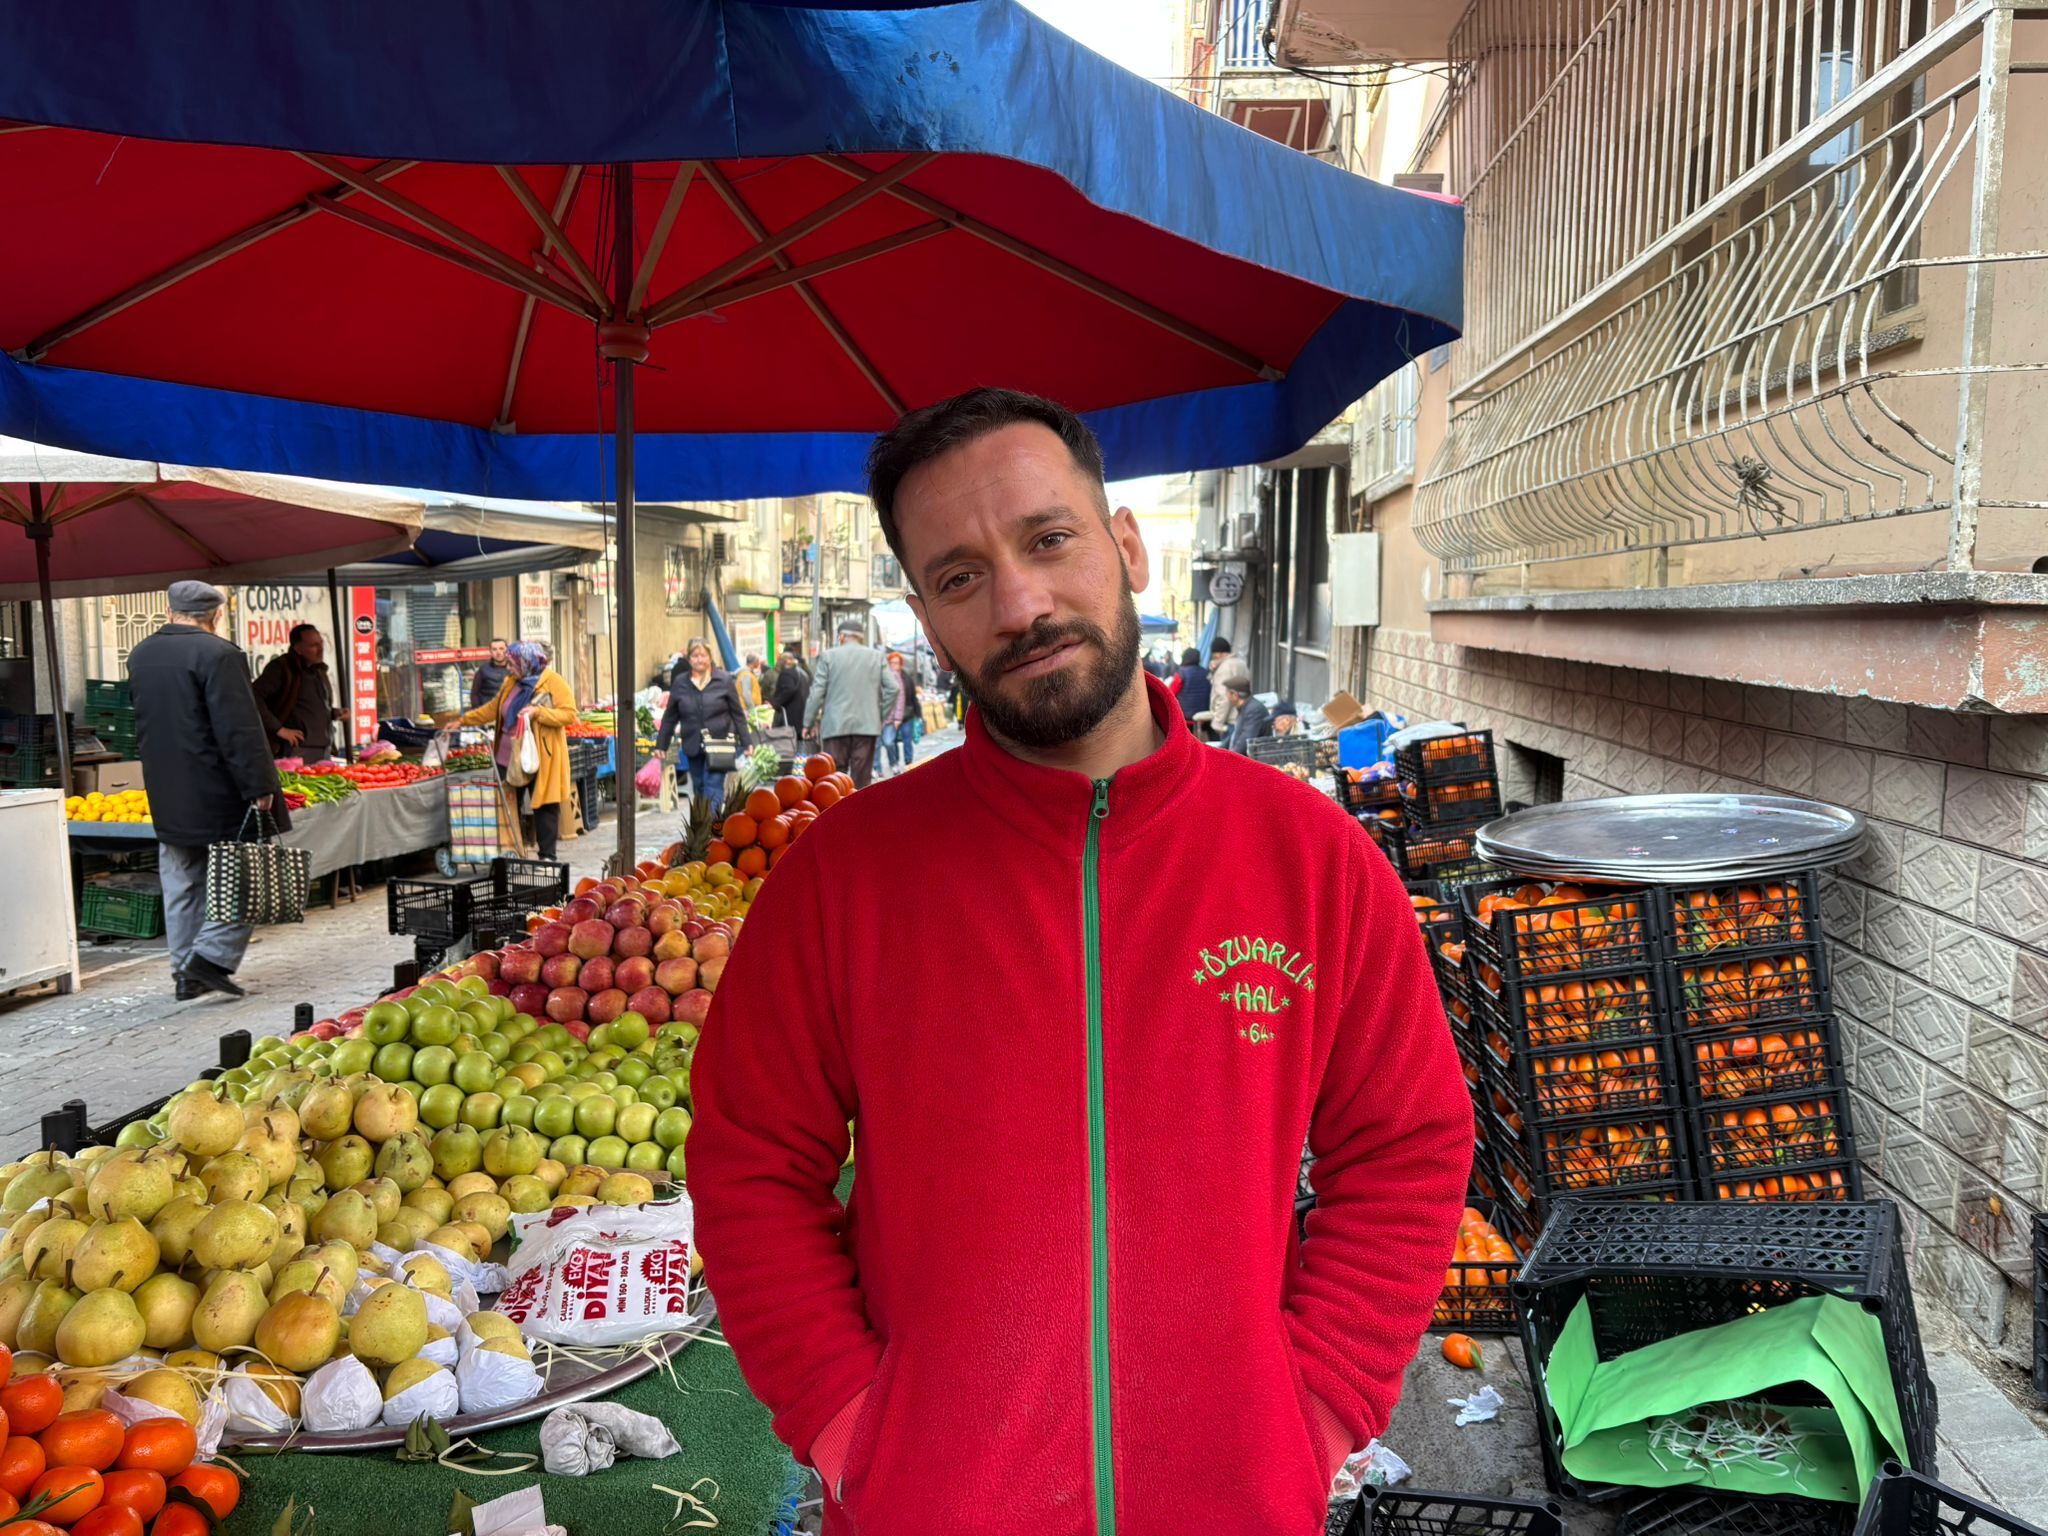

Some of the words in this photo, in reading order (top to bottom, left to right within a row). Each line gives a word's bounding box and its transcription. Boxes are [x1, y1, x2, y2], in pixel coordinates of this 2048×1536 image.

[246, 585, 302, 614] ÇORAP
[248, 616, 306, 645] PİJAM
[1235, 982, 1280, 1013] HAL
[568, 1253, 584, 1280] EKO
[620, 1265, 629, 1278] 180
[649, 1252, 664, 1277] EKO
